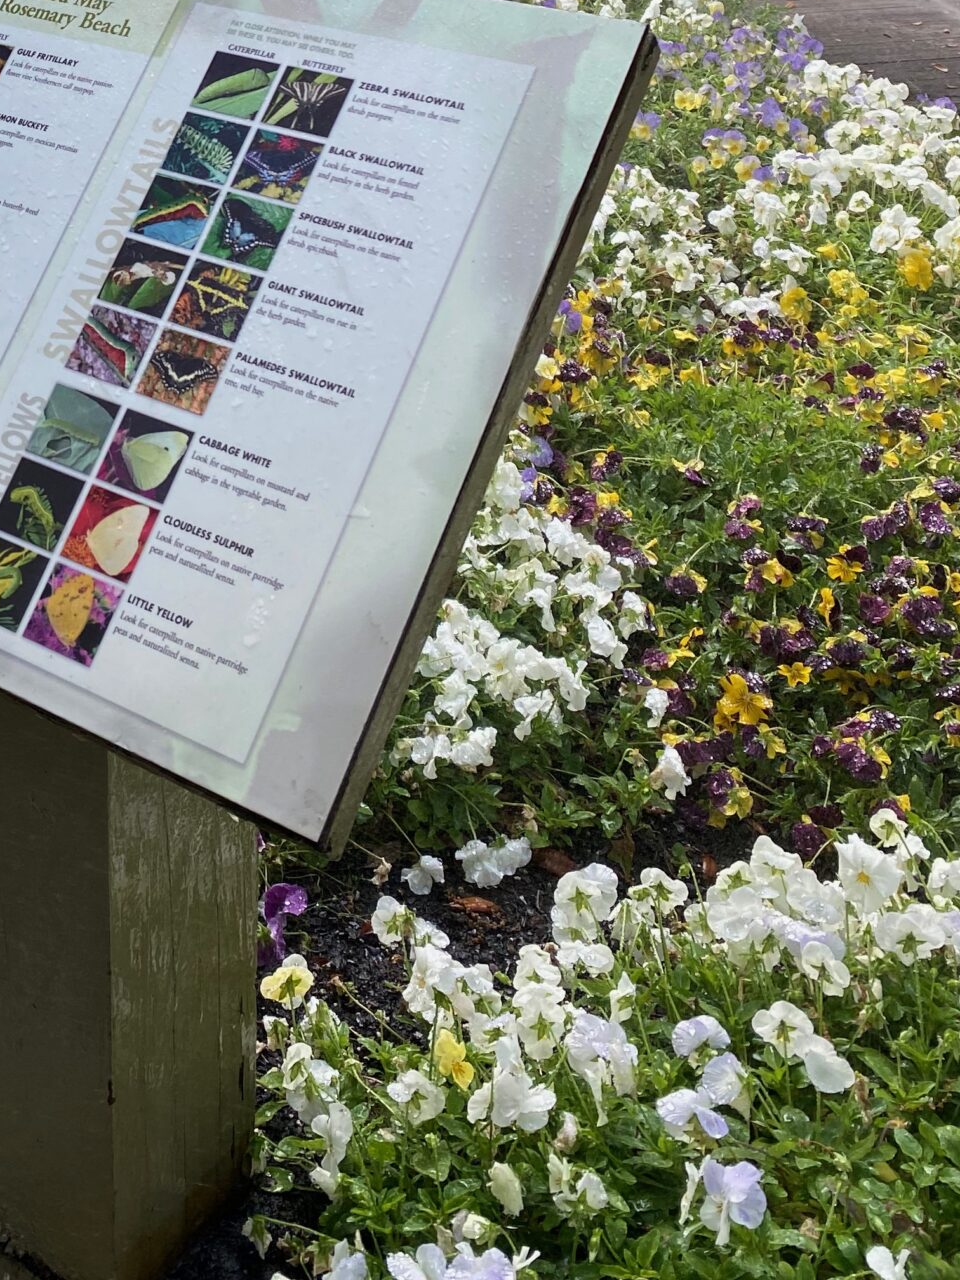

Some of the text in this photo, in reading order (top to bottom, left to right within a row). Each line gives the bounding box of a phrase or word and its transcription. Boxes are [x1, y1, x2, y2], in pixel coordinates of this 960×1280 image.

[79, 12, 131, 37] Beach
[10, 59, 24, 68] Look
[23, 62, 33, 70] for
[67, 72, 77, 81] the
[16, 48, 79, 67] GULF FRITILLARY
[228, 44, 345, 73] CATERPILLAR BUTTERFLY
[352, 94, 369, 105] Look
[369, 98, 380, 107] for
[427, 111, 439, 120] the
[358, 81, 464, 110] ZEBRA SWALLOWTAIL
[0, 129, 26, 140] caterpillars
[17, 118, 49, 132] BUCKEYE
[322, 159, 397, 185] Look for caterpillars on
[328, 146, 424, 175] BLACK SWALLOWTAIL
[316, 172, 374, 191] and the
[39, 115, 183, 366] SWALLOWTAILS
[292, 225, 309, 237] Look
[309, 230, 321, 240] for
[321, 236, 356, 250] caterpillars
[367, 246, 379, 256] the
[299, 212, 413, 249] SPICEBUSH SWALLOWTAIL
[255, 307, 267, 316] the
[261, 294, 336, 324] Look for caterpillars on
[268, 280, 364, 316] GIANT SWALLOWTAIL
[229, 364, 339, 408] Look for caterpillars on the native
[235, 352, 355, 398] PALAMEDES SWALLOWTAIL
[199, 435, 272, 468] CABBAGE WHITE
[184, 467, 211, 483] cabbage
[219, 479, 231, 490] the
[232, 485, 262, 501] vegetable
[191, 450, 311, 502] Look for caterpillars on mustard and
[163, 515, 254, 557] CLOUDLESS SULPHUR
[148, 546, 216, 577] peas and naturalized
[155, 531, 285, 591] Look for caterpillars on native partridge
[127, 594, 193, 628] LITTLE YELLOW
[112, 626, 128, 637] peas
[128, 633, 144, 643] and
[142, 639, 180, 660] naturalized
[119, 610, 249, 675] Look for caterpillars on native partridge
